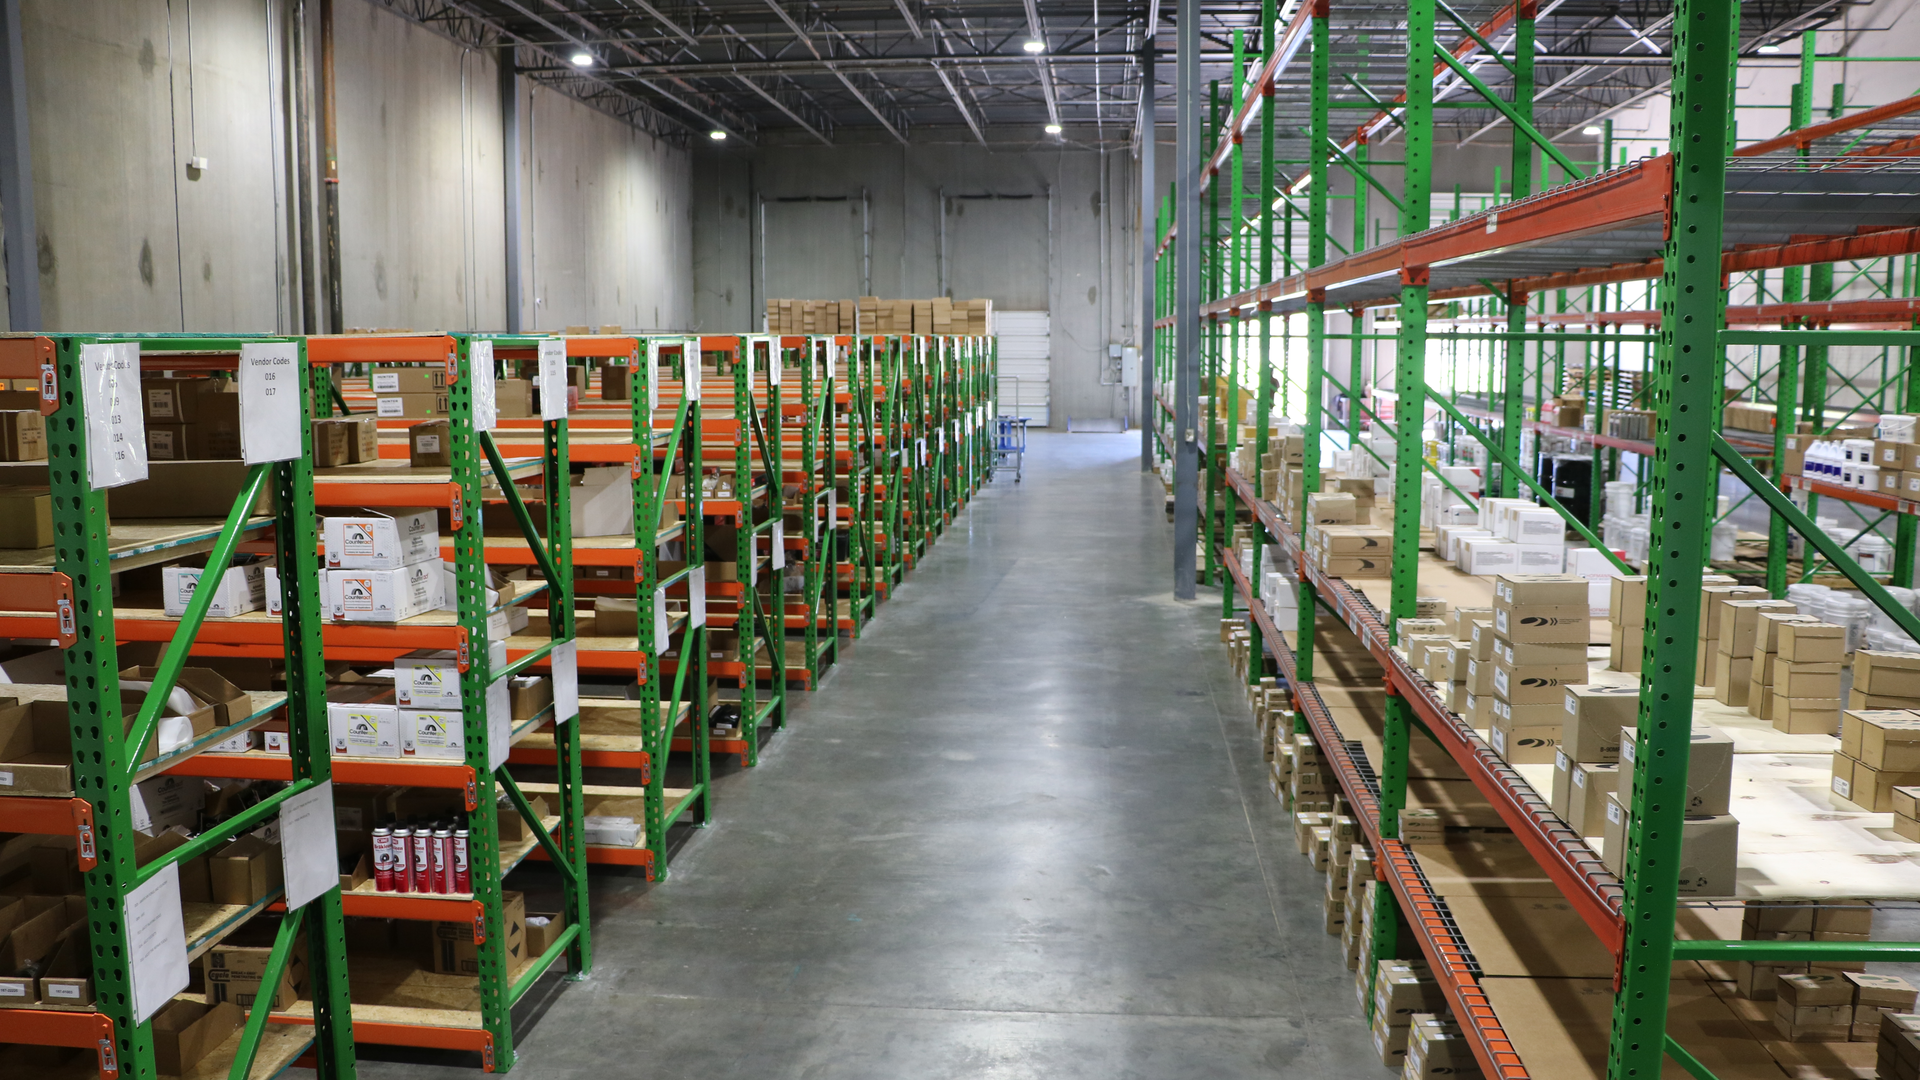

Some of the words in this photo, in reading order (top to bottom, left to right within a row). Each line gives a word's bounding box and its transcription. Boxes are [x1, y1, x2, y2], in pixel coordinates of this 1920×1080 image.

[94, 361, 114, 371] Veor
[114, 360, 130, 370] Cods
[250, 357, 272, 366] Vendor
[272, 356, 290, 365] Codes
[264, 372, 276, 380] 016
[266, 388, 276, 396] 017
[111, 415, 122, 424] 013
